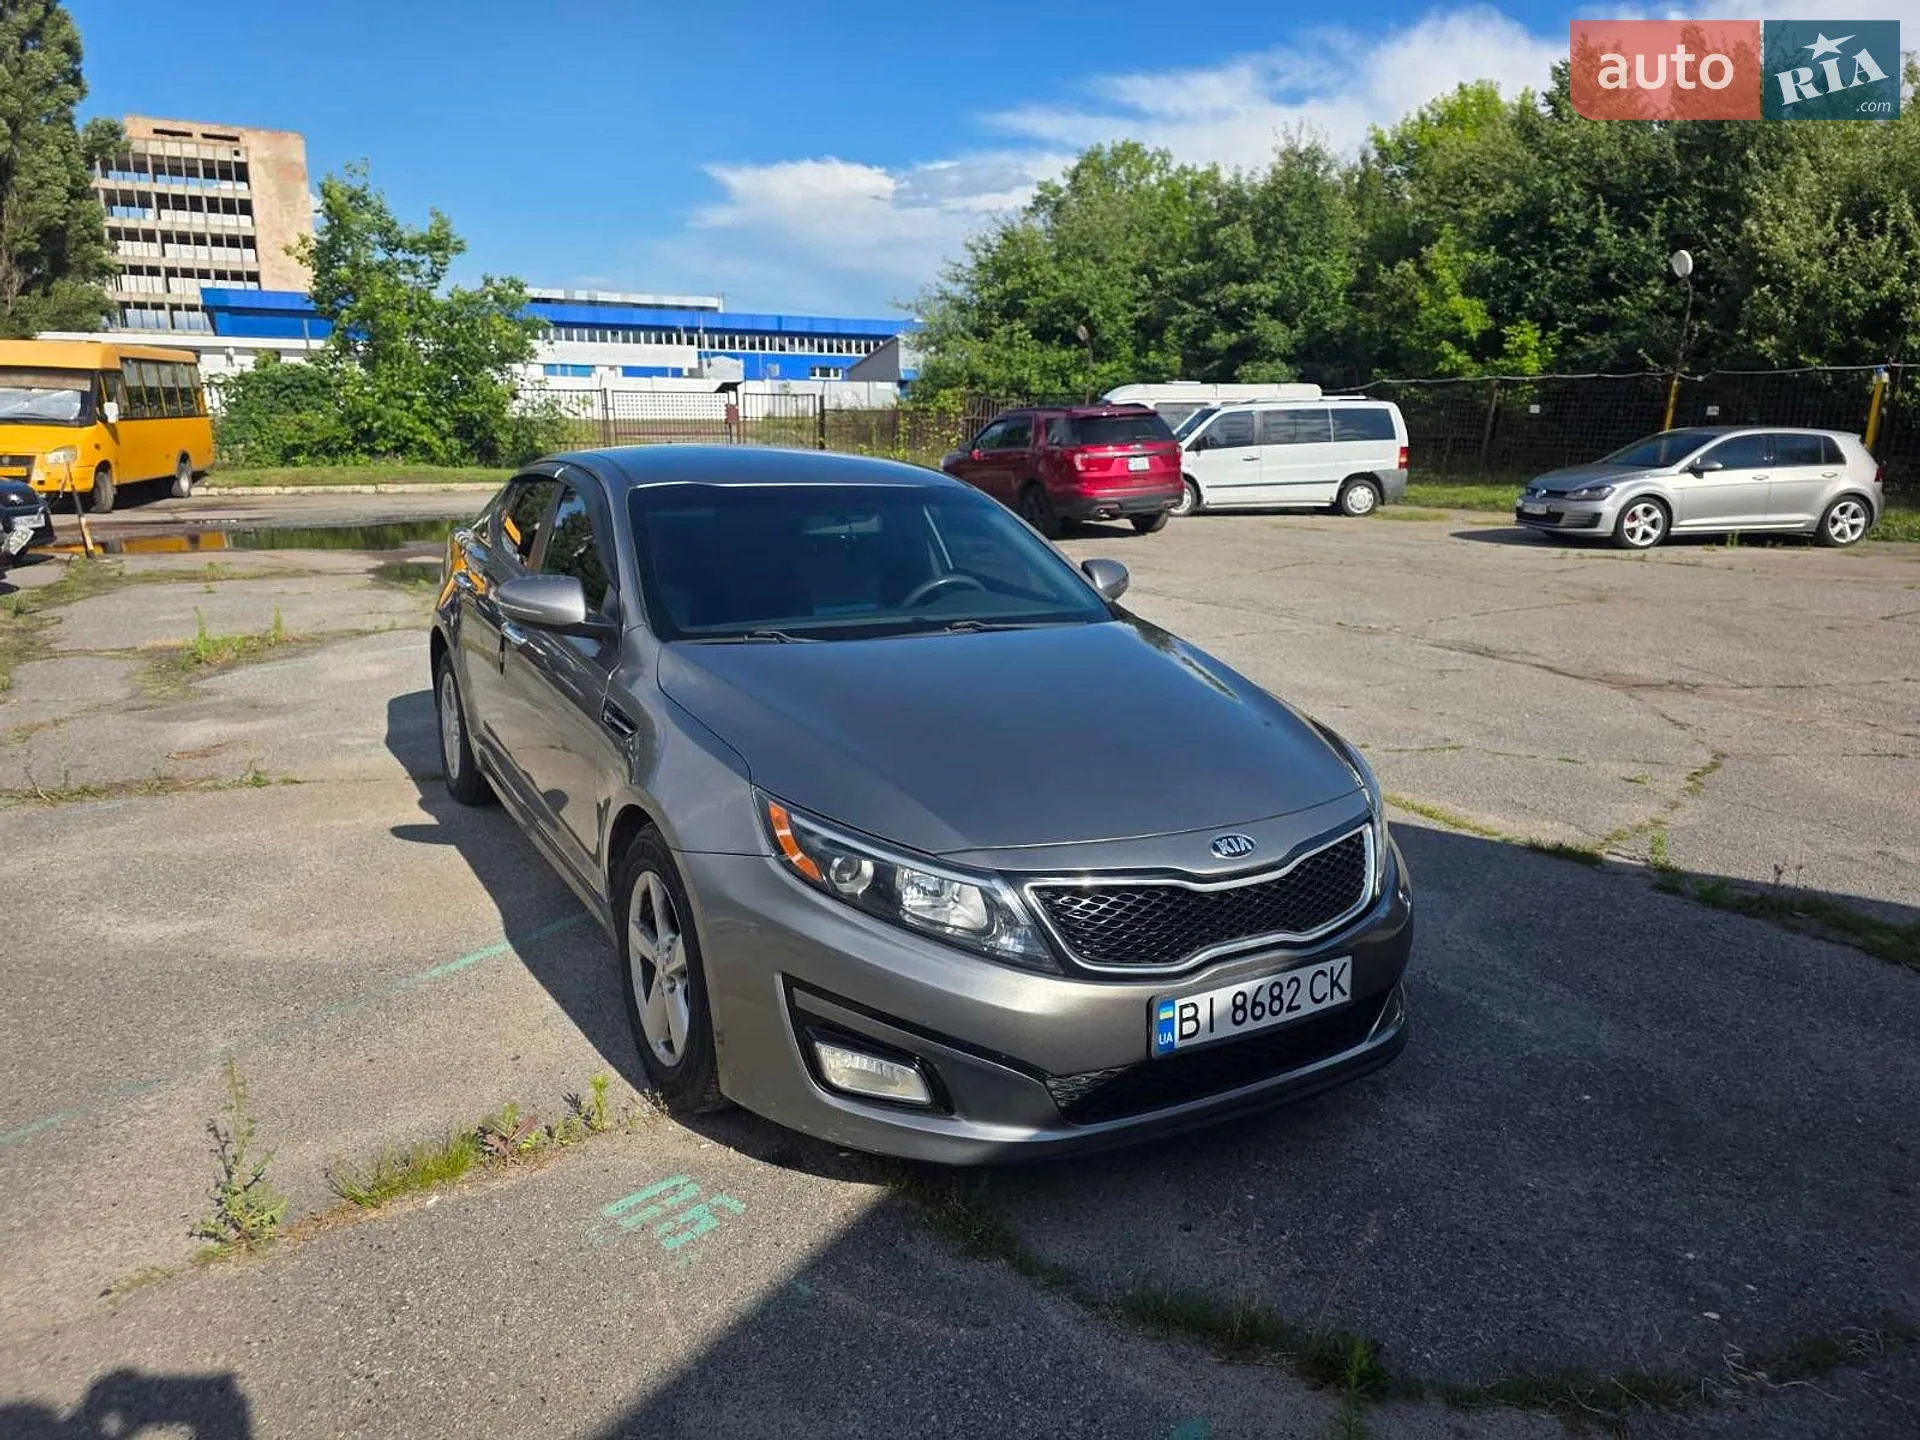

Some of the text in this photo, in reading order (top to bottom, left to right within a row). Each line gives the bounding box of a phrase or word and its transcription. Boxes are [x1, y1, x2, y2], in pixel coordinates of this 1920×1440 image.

[1214, 836, 1253, 856] KIA
[1178, 962, 1348, 1041] BI 8682 CK
[1158, 1031, 1174, 1045] UA
